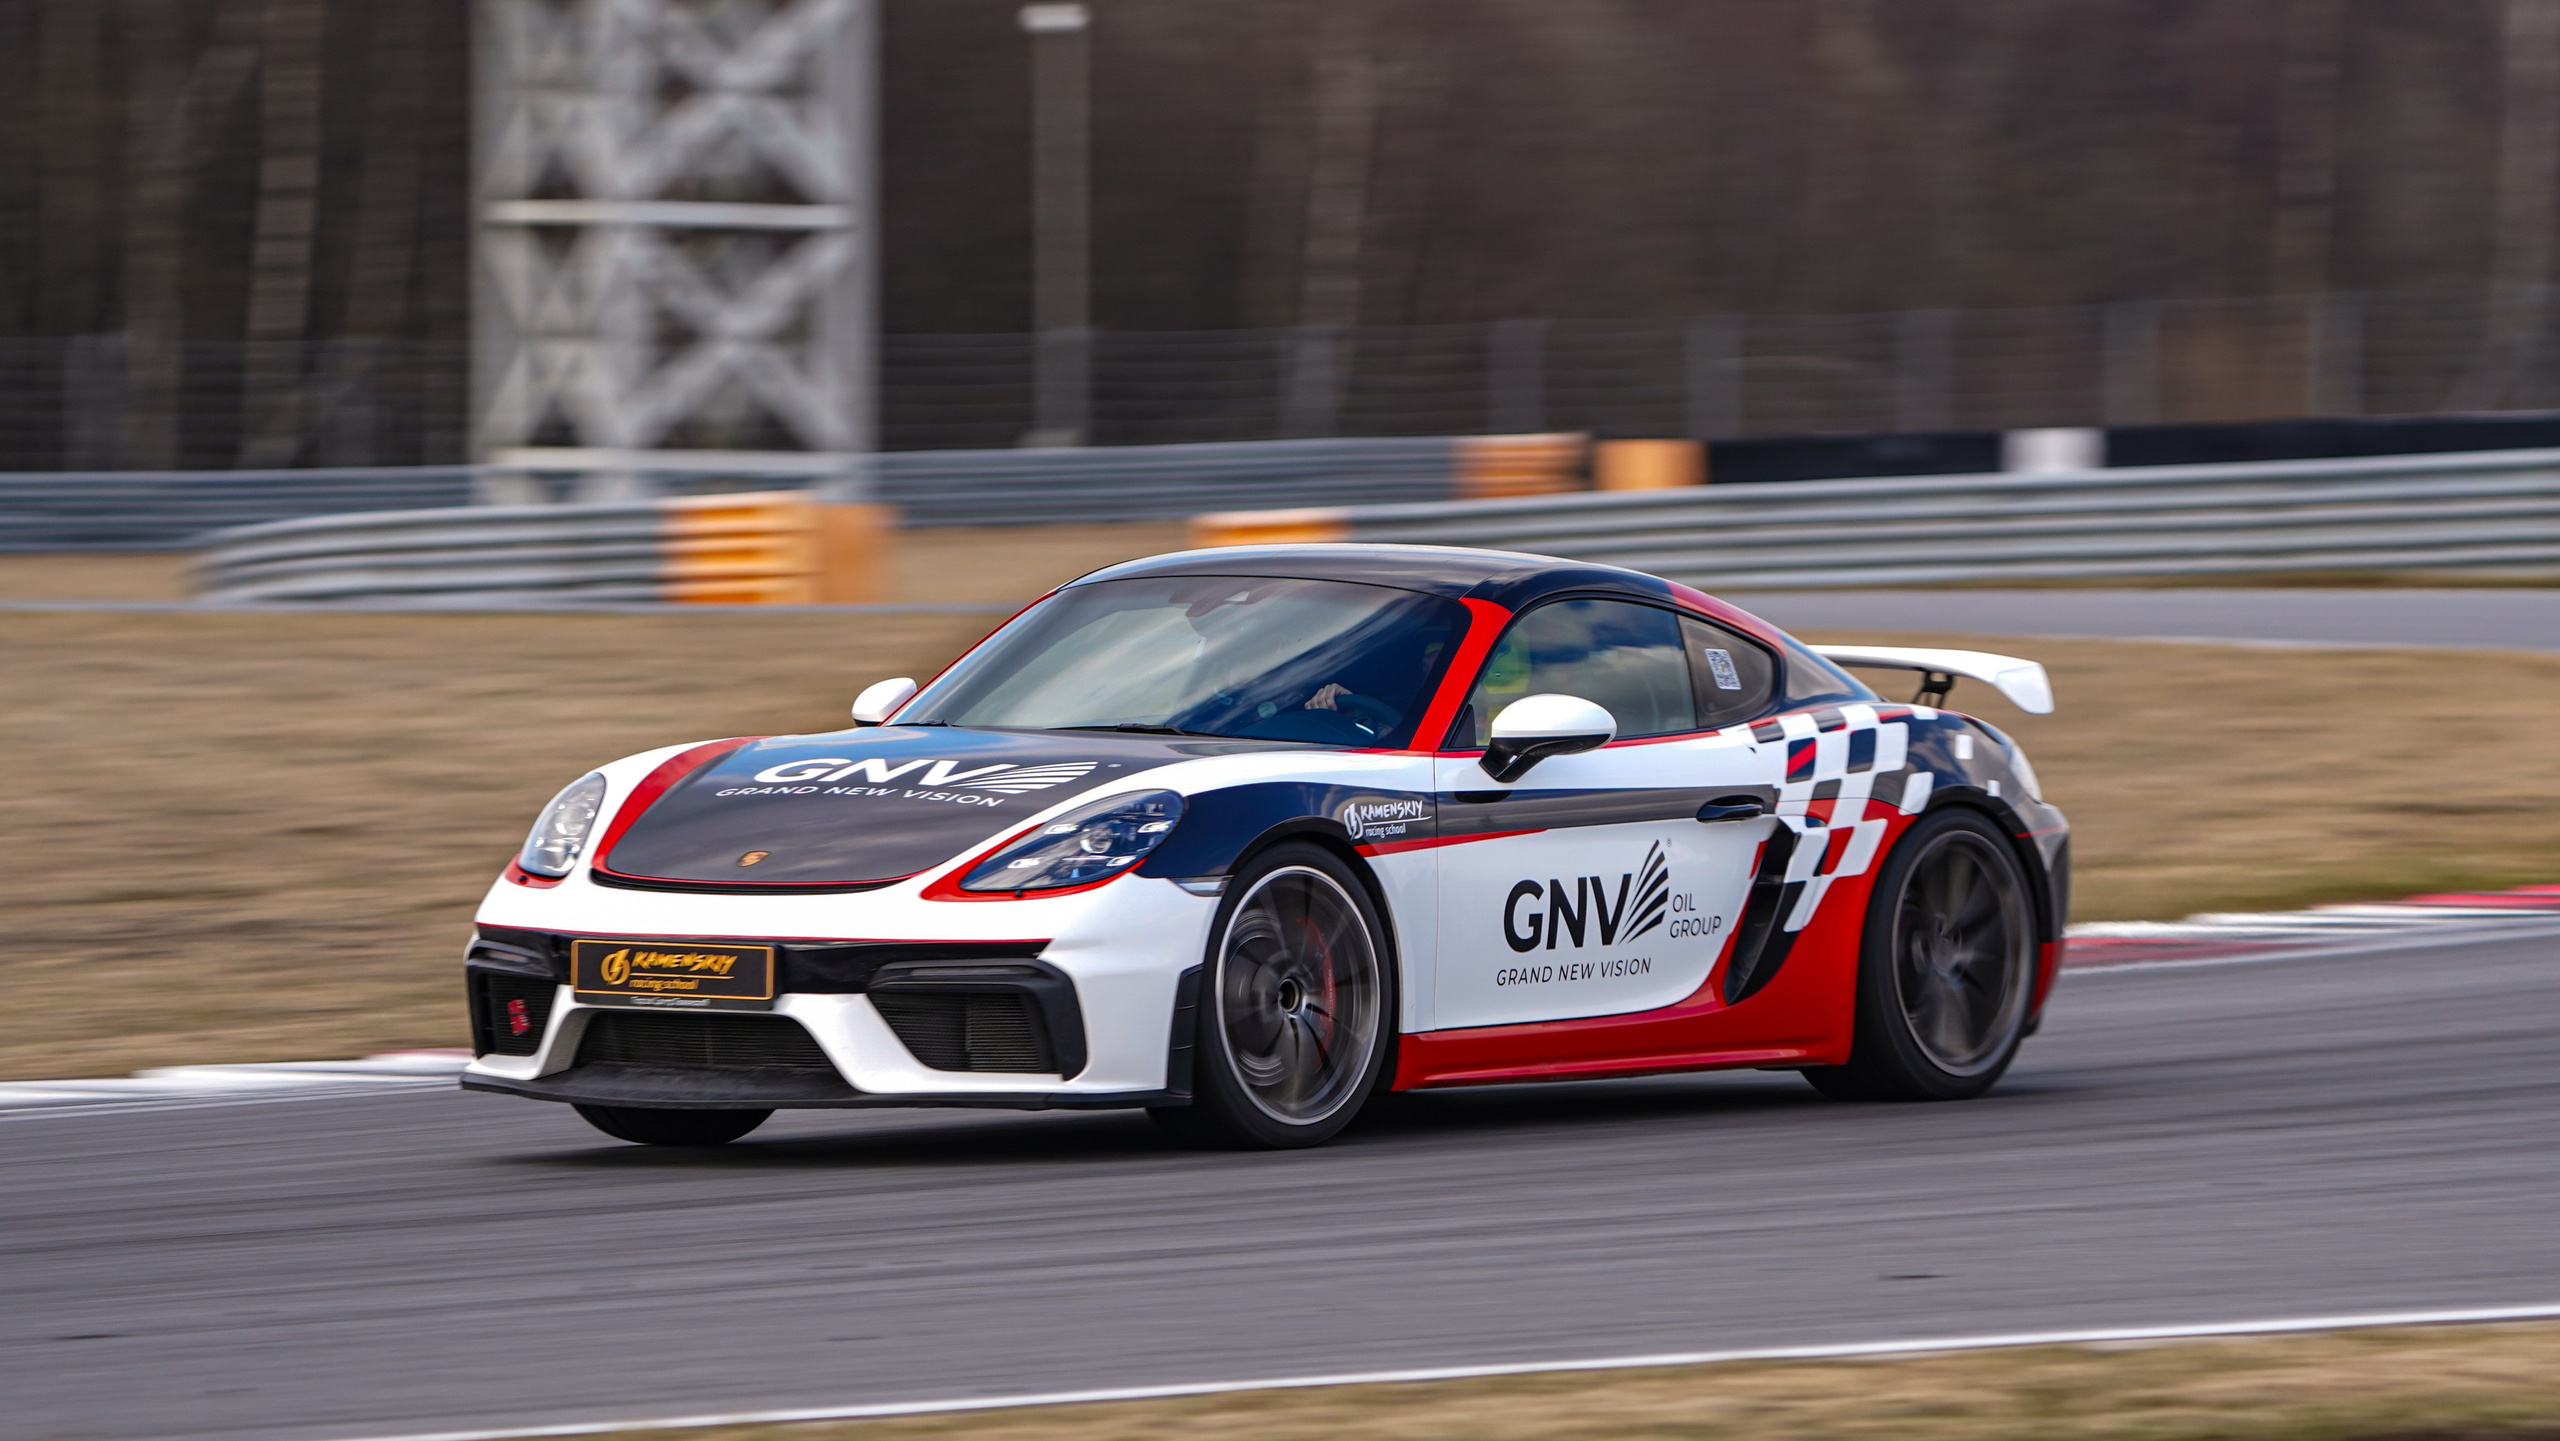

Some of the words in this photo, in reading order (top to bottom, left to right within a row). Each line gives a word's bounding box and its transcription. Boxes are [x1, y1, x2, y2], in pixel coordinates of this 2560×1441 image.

[754, 758, 1019, 786] GNV
[716, 785, 819, 797] GRAND
[823, 786, 899, 797] NEW
[903, 789, 1005, 807] VISION
[1360, 800, 1423, 821] KAMENSKIY
[1365, 826, 1386, 839] racing
[1386, 823, 1407, 836] school
[1503, 873, 1633, 953] GNV
[1672, 893, 1697, 913] OIL
[1669, 916, 1722, 939] GROUP
[632, 951, 738, 975] KAMENSKIY
[1496, 966, 1553, 987] GRAND
[1558, 962, 1596, 982] NEW
[1600, 957, 1652, 978] VISION
